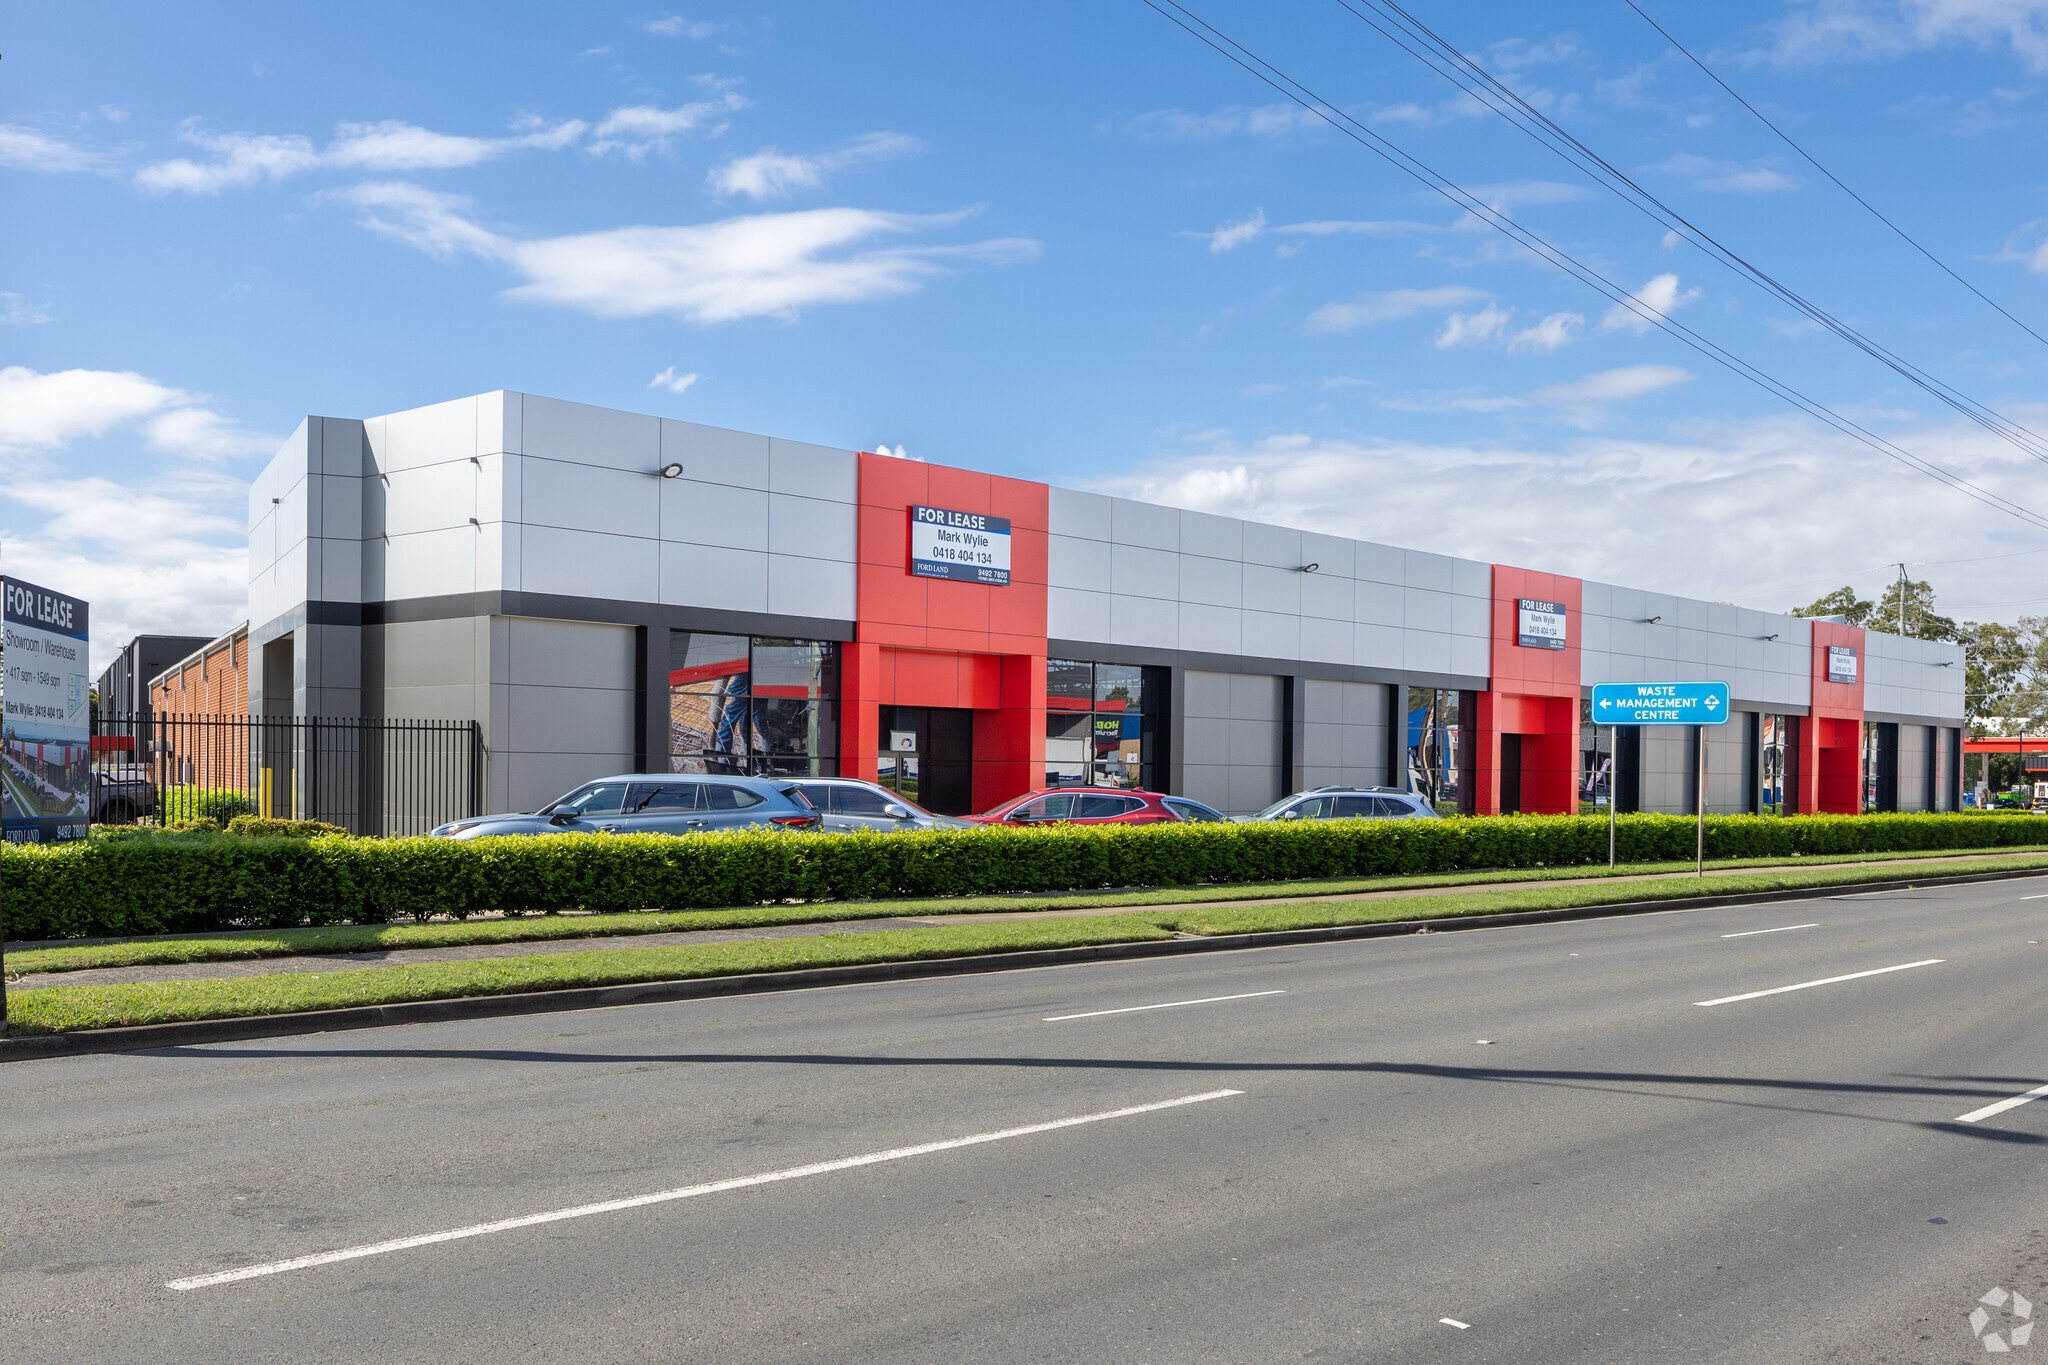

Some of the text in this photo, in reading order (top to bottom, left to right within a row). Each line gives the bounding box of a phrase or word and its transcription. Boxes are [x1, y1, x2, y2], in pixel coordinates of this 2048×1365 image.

[918, 507, 986, 530] FOR LEASE
[938, 529, 988, 548] Mark Wylie
[933, 546, 992, 564] 0418 404 134
[918, 563, 948, 573] FORD LAND
[978, 568, 1008, 579] 9492 7800
[7, 584, 73, 629] FOR LEASE
[1522, 600, 1554, 612] FOR LEASE
[6, 629, 40, 652] Showroom
[44, 638, 76, 660] Warehouse
[10, 666, 20, 680] 417
[21, 670, 32, 685] sqm
[37, 672, 50, 685] 1549
[50, 675, 60, 690] sqm
[1638, 686, 1676, 696] WASTE
[6, 700, 18, 714] Mark
[35, 704, 46, 718] 0418
[47, 706, 56, 719] 404
[1616, 698, 1698, 708] MANAGEMENT
[1634, 710, 1679, 720] CENTRE
[24, 828, 40, 842] LAND
[56, 824, 86, 838] 9492 7800
